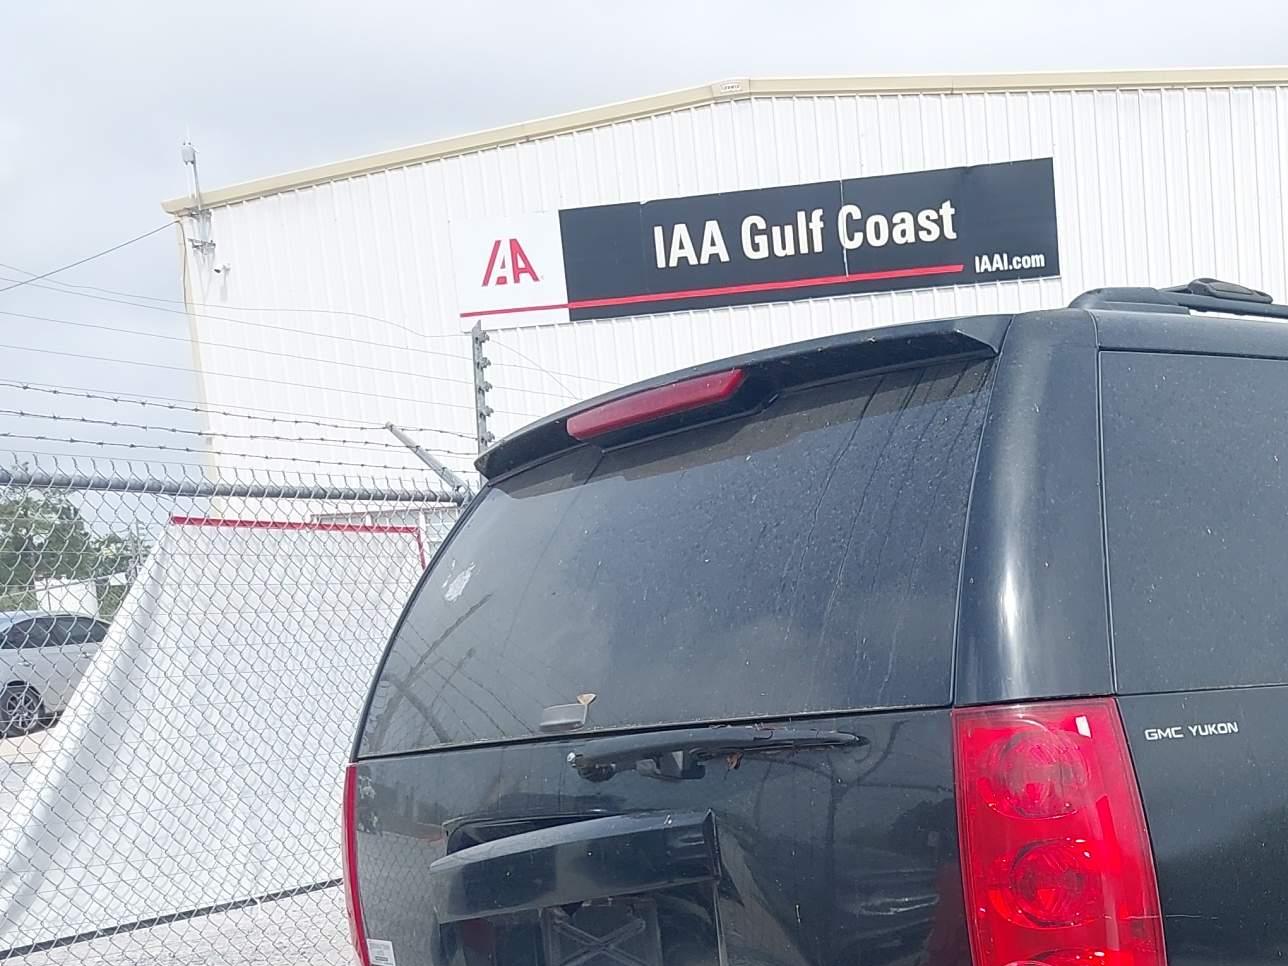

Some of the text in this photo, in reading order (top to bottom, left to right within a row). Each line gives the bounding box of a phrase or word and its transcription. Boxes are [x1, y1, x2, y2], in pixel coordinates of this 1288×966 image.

[653, 199, 958, 269] IAA Gulf Coast
[974, 252, 1046, 273] IAAI.com
[1144, 721, 1239, 741] GMC YUKON
